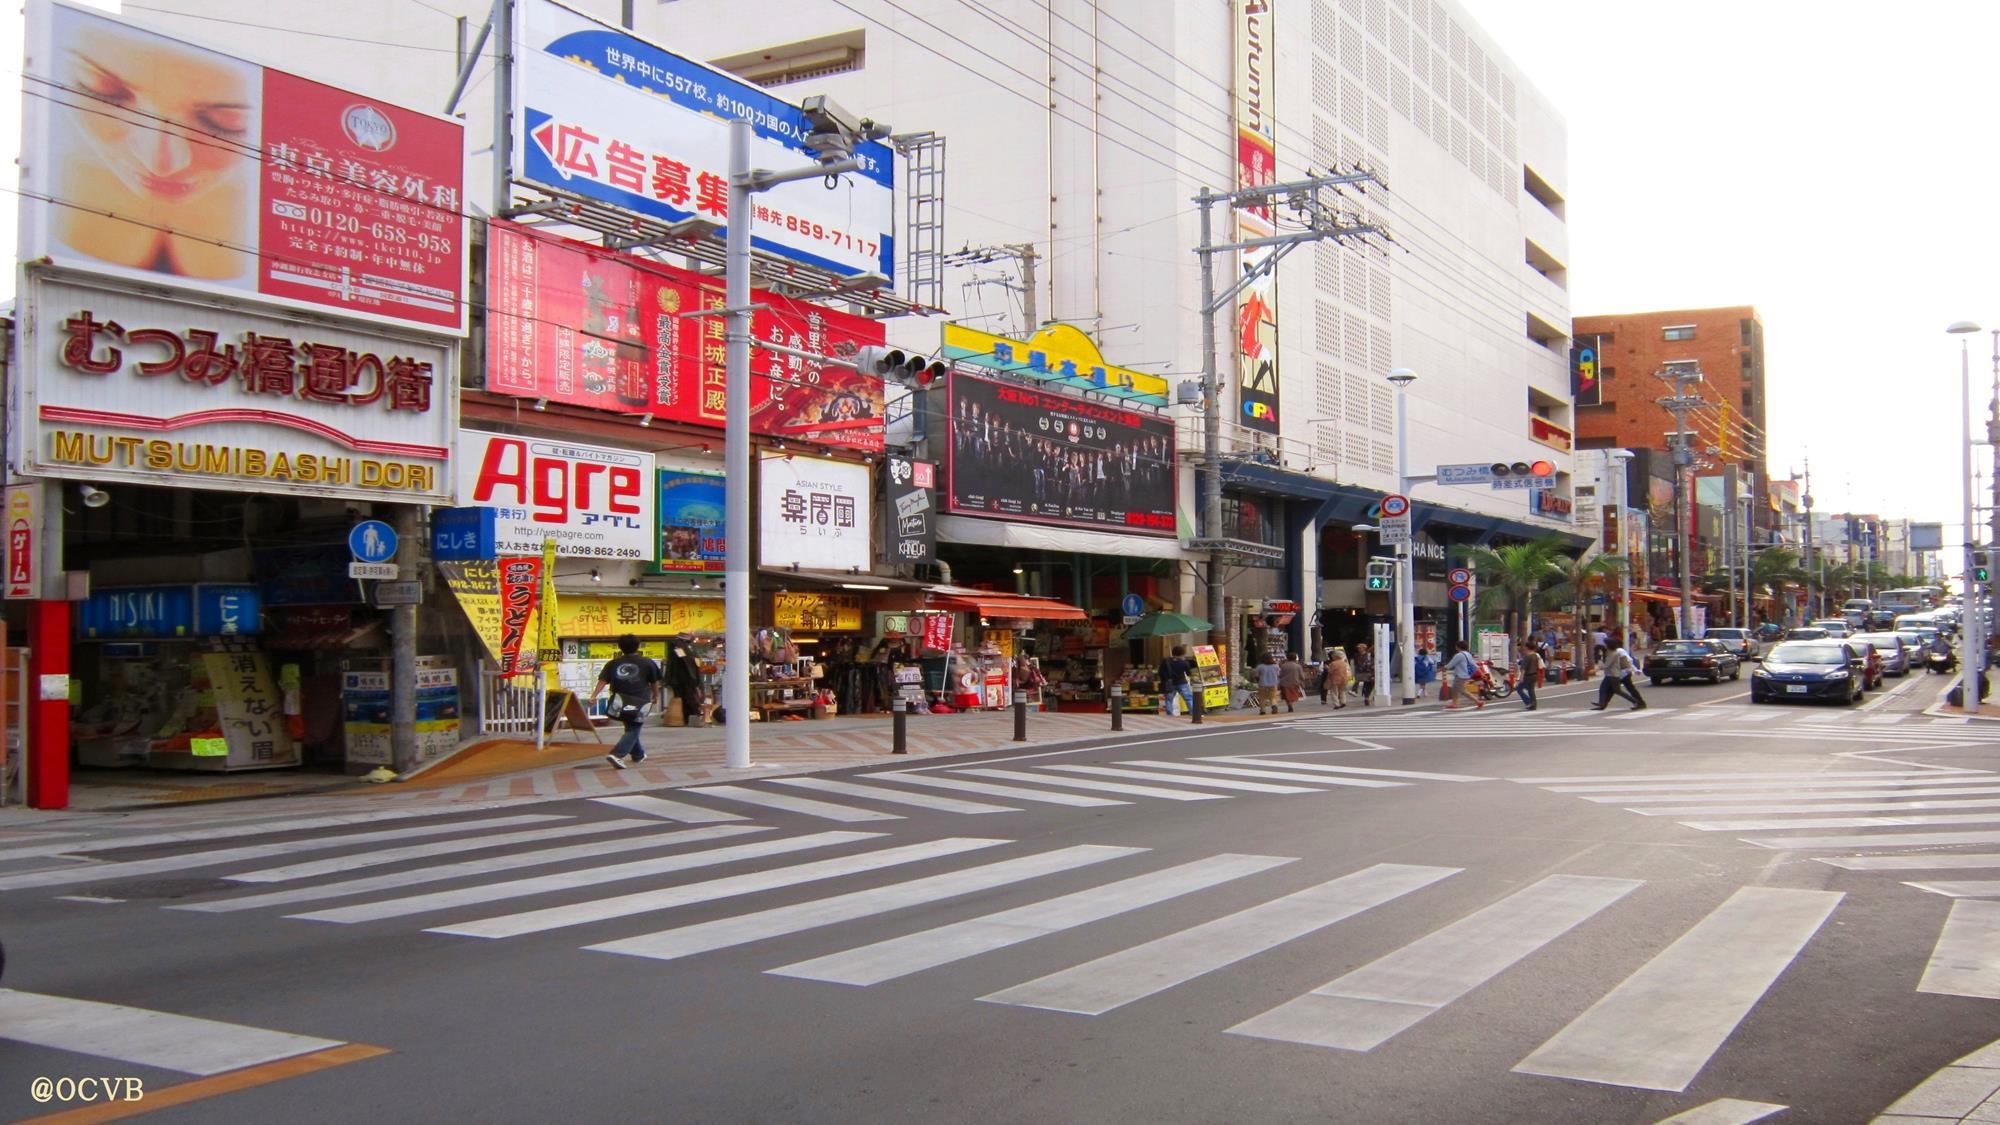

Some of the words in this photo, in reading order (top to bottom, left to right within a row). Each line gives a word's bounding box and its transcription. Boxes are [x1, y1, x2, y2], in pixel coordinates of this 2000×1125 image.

[351, 115, 387, 134] TOKYO
[267, 142, 460, 211] 東京美容外科
[556, 125, 728, 219] 広告募集
[310, 207, 451, 255] 0120-658-958
[786, 216, 878, 258] 859-7117
[289, 236, 425, 275] 完全予約制・年中無休
[61, 310, 434, 413] むつみ橋通り街
[1579, 347, 1596, 393] OPA
[1243, 400, 1276, 422] OPA
[54, 430, 352, 483] MUTSUMIBASHI
[359, 458, 434, 491] DORI
[1441, 466, 1490, 477] むつみ橋
[473, 438, 641, 524] Agre
[795, 480, 818, 489] ASIAN
[819, 482, 843, 492] STYLE
[494, 507, 527, 520] 発行)
[581, 512, 641, 529] アグレ
[436, 531, 477, 550] にしき
[514, 526, 604, 541] http://webagre.com
[13, 533, 27, 582] ゲーム
[1411, 541, 1446, 560] HANCE
[577, 614, 608, 624] STYLE
[579, 605, 608, 613] ASIAN
